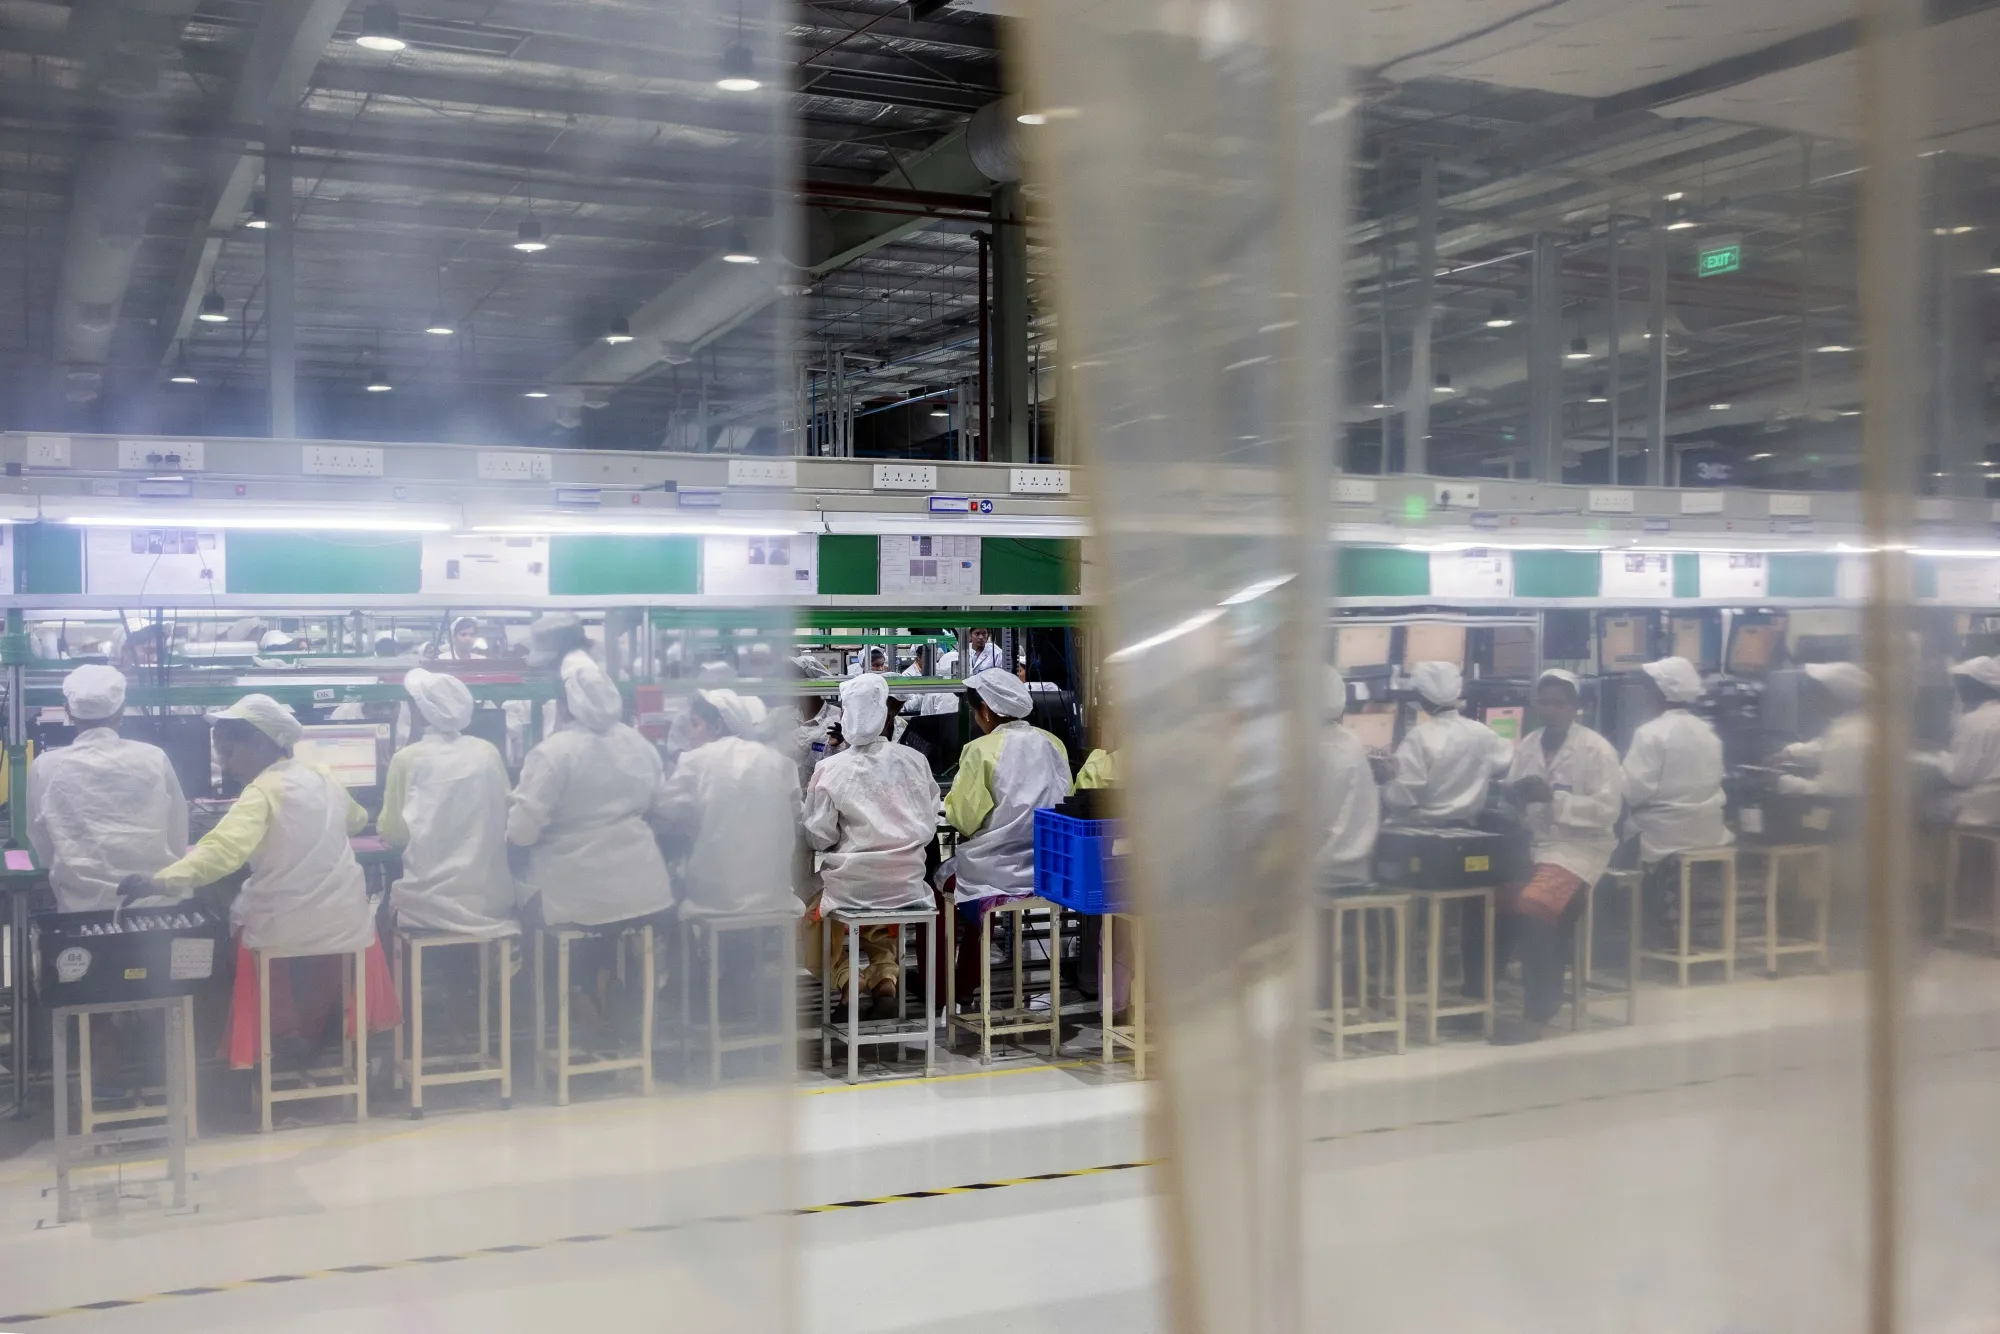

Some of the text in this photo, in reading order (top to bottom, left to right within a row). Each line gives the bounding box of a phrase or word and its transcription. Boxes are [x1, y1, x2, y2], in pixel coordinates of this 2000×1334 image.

[1707, 252, 1731, 269] EXIT
[981, 502, 992, 511] 34
[317, 691, 330, 699] OK
